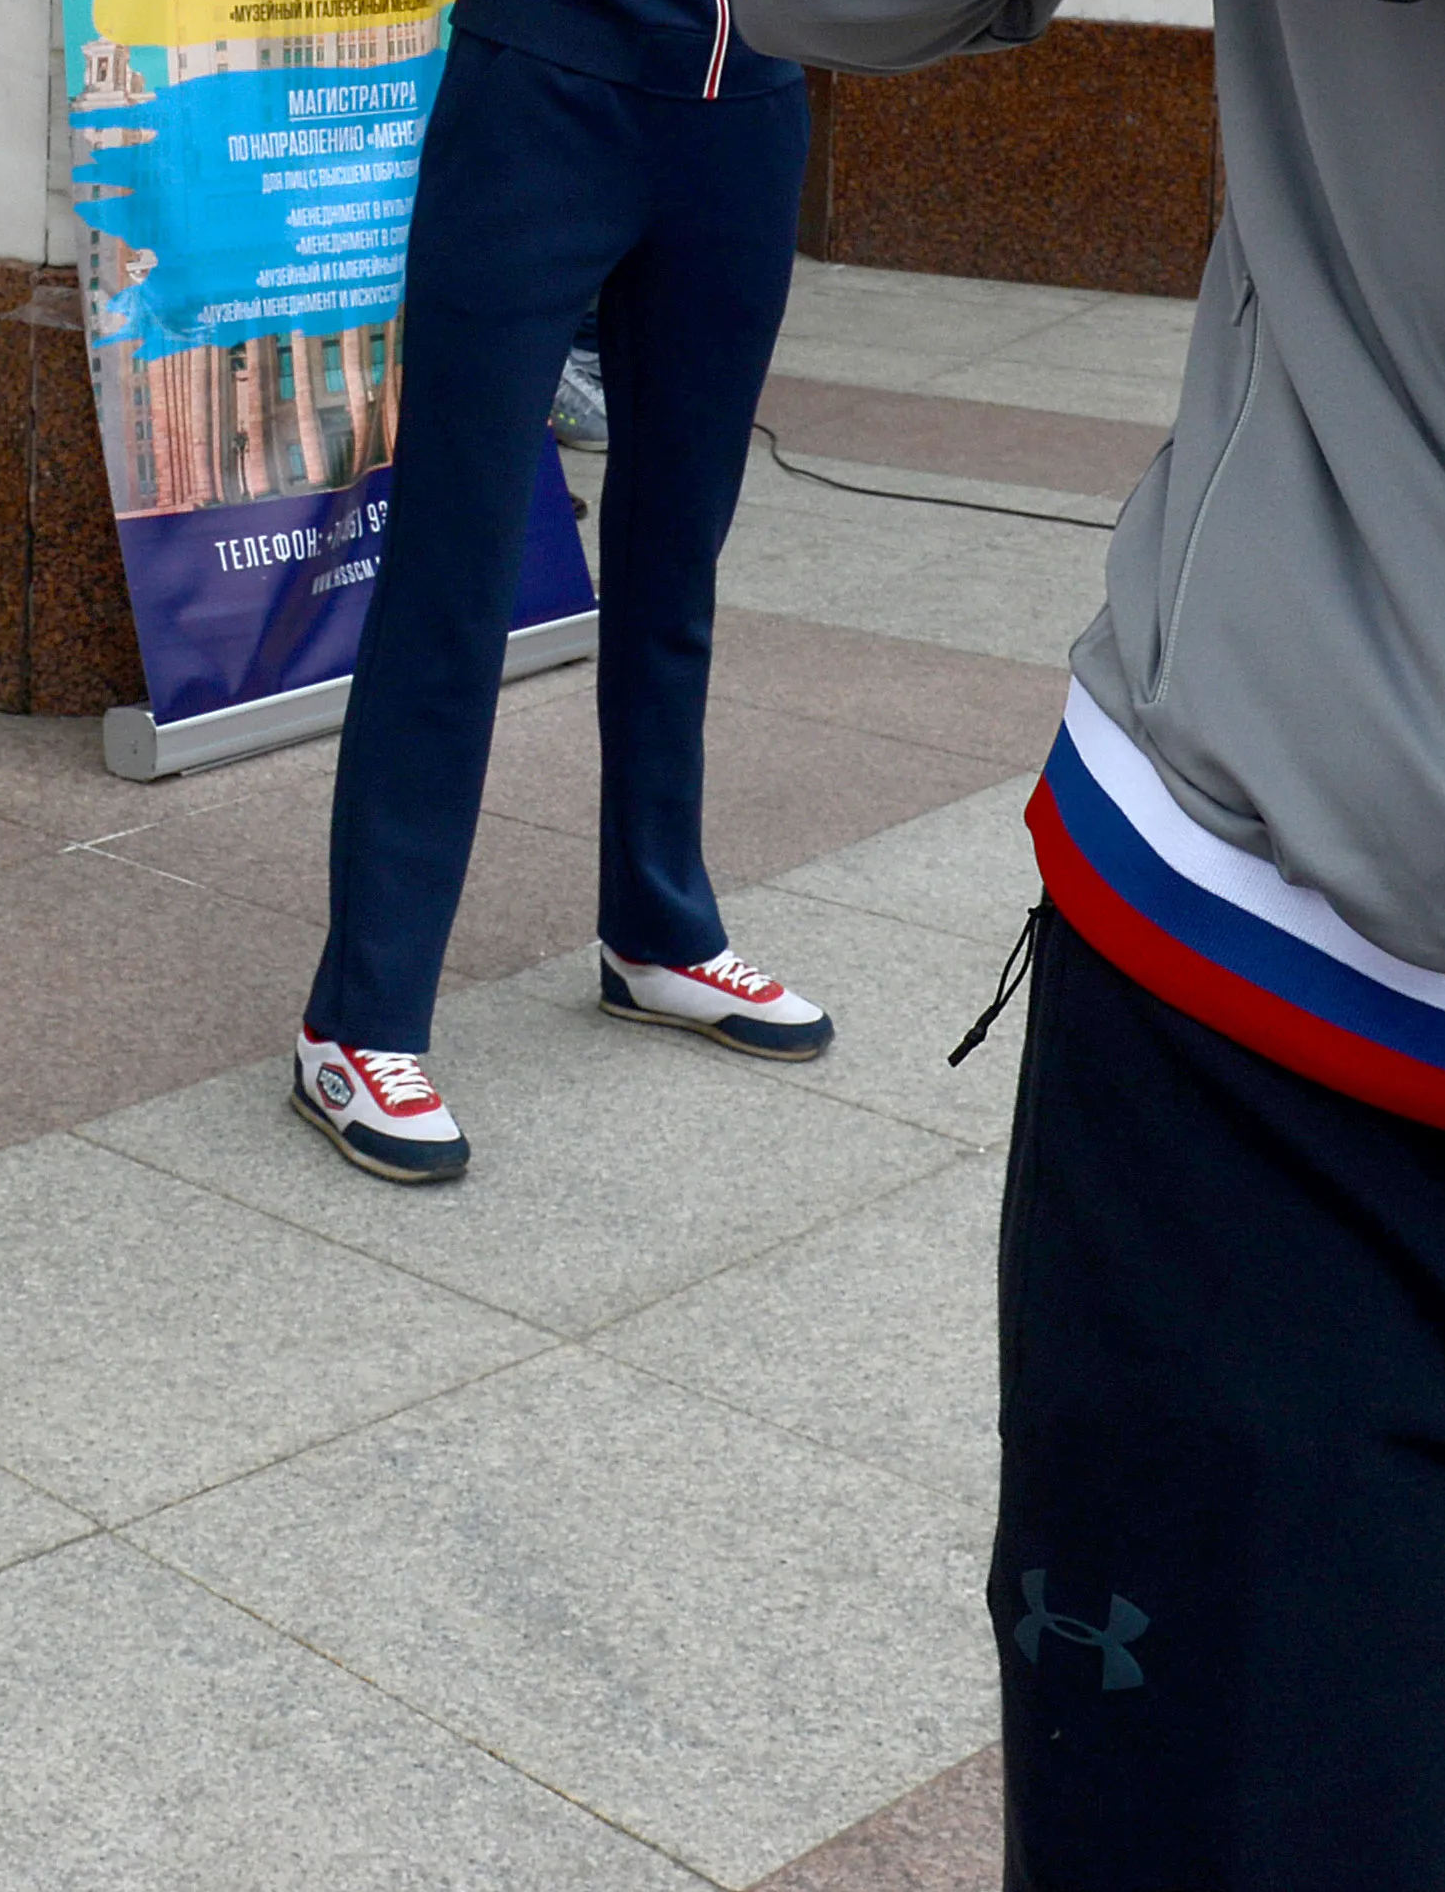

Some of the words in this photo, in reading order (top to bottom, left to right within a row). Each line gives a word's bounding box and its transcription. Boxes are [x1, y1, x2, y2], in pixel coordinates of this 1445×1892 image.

[229, 0, 302, 23] «МУЗЕЙНЫЙ
[305, 0, 314, 19] И
[288, 80, 417, 116] МАГИСТРАТУРА
[228, 135, 248, 162] ПО
[251, 125, 364, 160] НАПРАВЛЕНИЮ
[373, 200, 381, 220] В
[381, 228, 389, 247] В
[321, 262, 331, 283] И
[340, 290, 348, 308] И
[214, 527, 322, 572] ТЕЛЕФОН:
